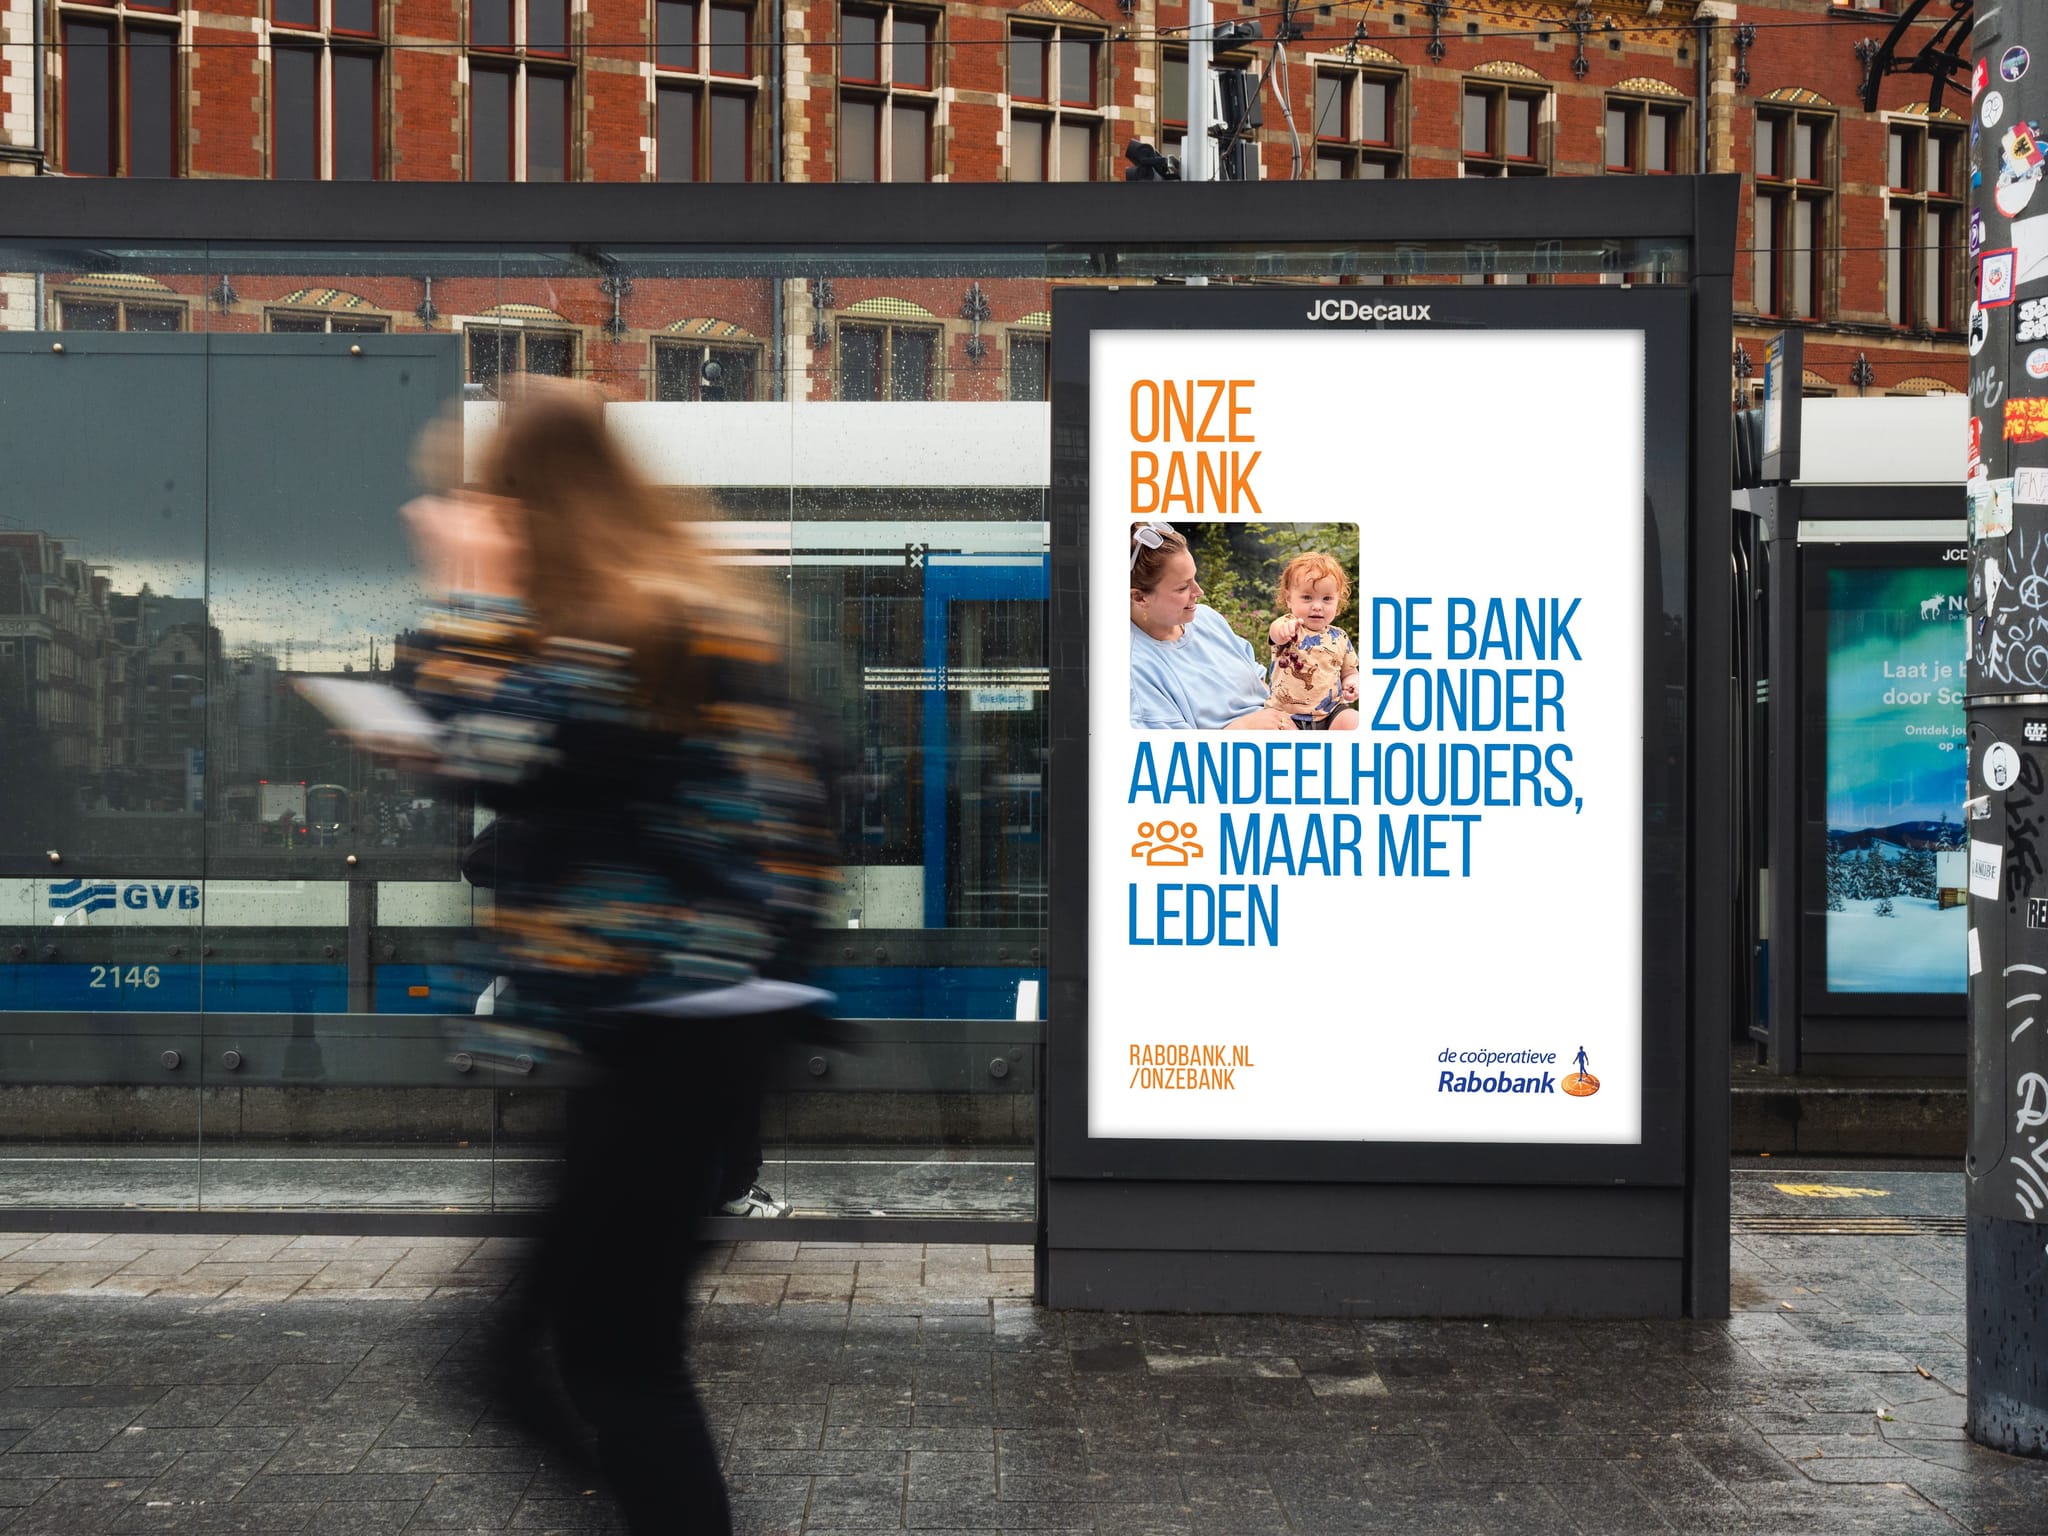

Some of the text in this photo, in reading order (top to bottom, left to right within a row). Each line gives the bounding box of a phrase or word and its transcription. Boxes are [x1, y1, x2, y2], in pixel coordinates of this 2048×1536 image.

[1307, 300, 1431, 321] JCDecaux
[1130, 380, 1256, 443] ONZE
[1130, 451, 1263, 514] BANK
[1373, 597, 1583, 661] DE BANK
[1883, 661, 1928, 678] Laat
[1932, 661, 1953, 682] je
[1371, 668, 1566, 733] ZONDER
[1883, 687, 1966, 705] door Sc
[1905, 724, 1948, 736] Ontdek
[1938, 742, 1954, 753] op
[1128, 742, 1583, 814] AANDEELHOUDERS,
[1220, 813, 1482, 878] MAAR MET
[123, 884, 200, 910] GVB
[1129, 883, 1279, 947] LEDEN
[90, 966, 160, 988] 2146
[1129, 1044, 1255, 1067] RABOBANK.NL
[1438, 1048, 1557, 1067] de coöperatieve
[1129, 1067, 1235, 1090] /ONZEBANK
[1438, 1070, 1556, 1094] Rabobank
